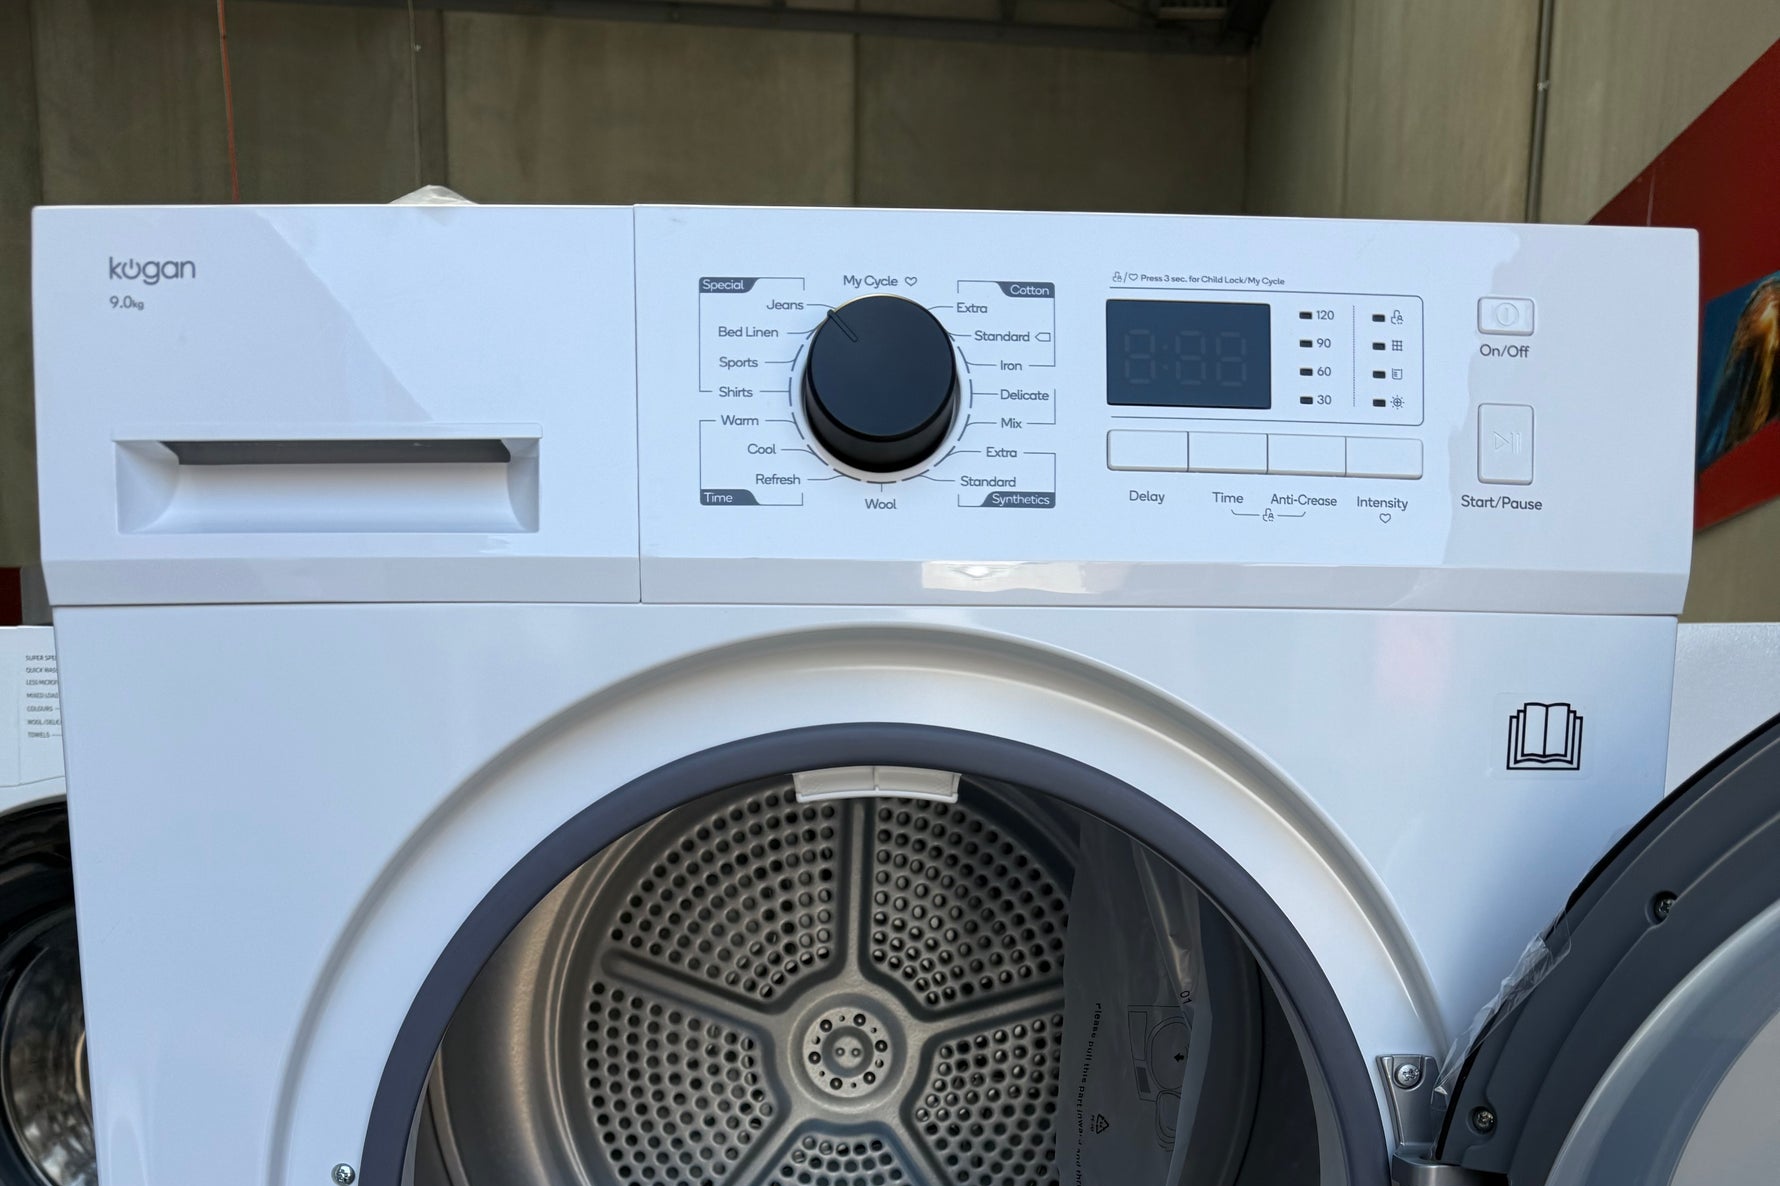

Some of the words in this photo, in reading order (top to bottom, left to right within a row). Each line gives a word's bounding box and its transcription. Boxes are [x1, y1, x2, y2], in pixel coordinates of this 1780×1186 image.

[109, 256, 196, 285] kogan
[702, 279, 744, 291] Special
[843, 275, 862, 288] My
[864, 275, 898, 288] Cycle
[1189, 275, 1200, 283] for
[1201, 276, 1223, 284] Child
[1224, 276, 1260, 286] Lock/My
[1262, 277, 1285, 286] Cycle
[1010, 284, 1050, 296] Cotton
[109, 295, 144, 311] 9.0kg
[766, 299, 804, 311] Jeans
[957, 303, 988, 314] Extra
[1316, 310, 1335, 321] 120
[718, 327, 744, 337] Bed
[746, 326, 779, 337] Linen
[974, 331, 1030, 343] Standard
[1316, 338, 1331, 349] 90
[1479, 344, 1530, 358] On/Off
[719, 357, 758, 370] Sports
[1000, 360, 1022, 371] Iron
[1316, 366, 1332, 377] 60
[719, 386, 753, 398] Shirts
[1000, 389, 1050, 401] Delicate
[1316, 394, 1332, 406] 30
[721, 415, 759, 426] Warm
[1001, 418, 1022, 429] Mix
[748, 443, 776, 455] Cool
[986, 447, 1017, 458] Extra
[756, 473, 801, 485] Refresh
[960, 476, 1016, 488] Standard
[704, 492, 733, 503] Time
[992, 493, 1050, 506] Synthetics
[1129, 491, 1165, 506] Delay
[1212, 492, 1244, 504] Time
[1271, 493, 1338, 507] Anti-Crease
[1357, 495, 1408, 512] Intensity
[1461, 495, 1543, 512] Start/Pause
[865, 498, 897, 510] Wool
[1085, 1041, 1094, 1061] pull
[1081, 1063, 1090, 1083] this
[1076, 1086, 1085, 1107] part
